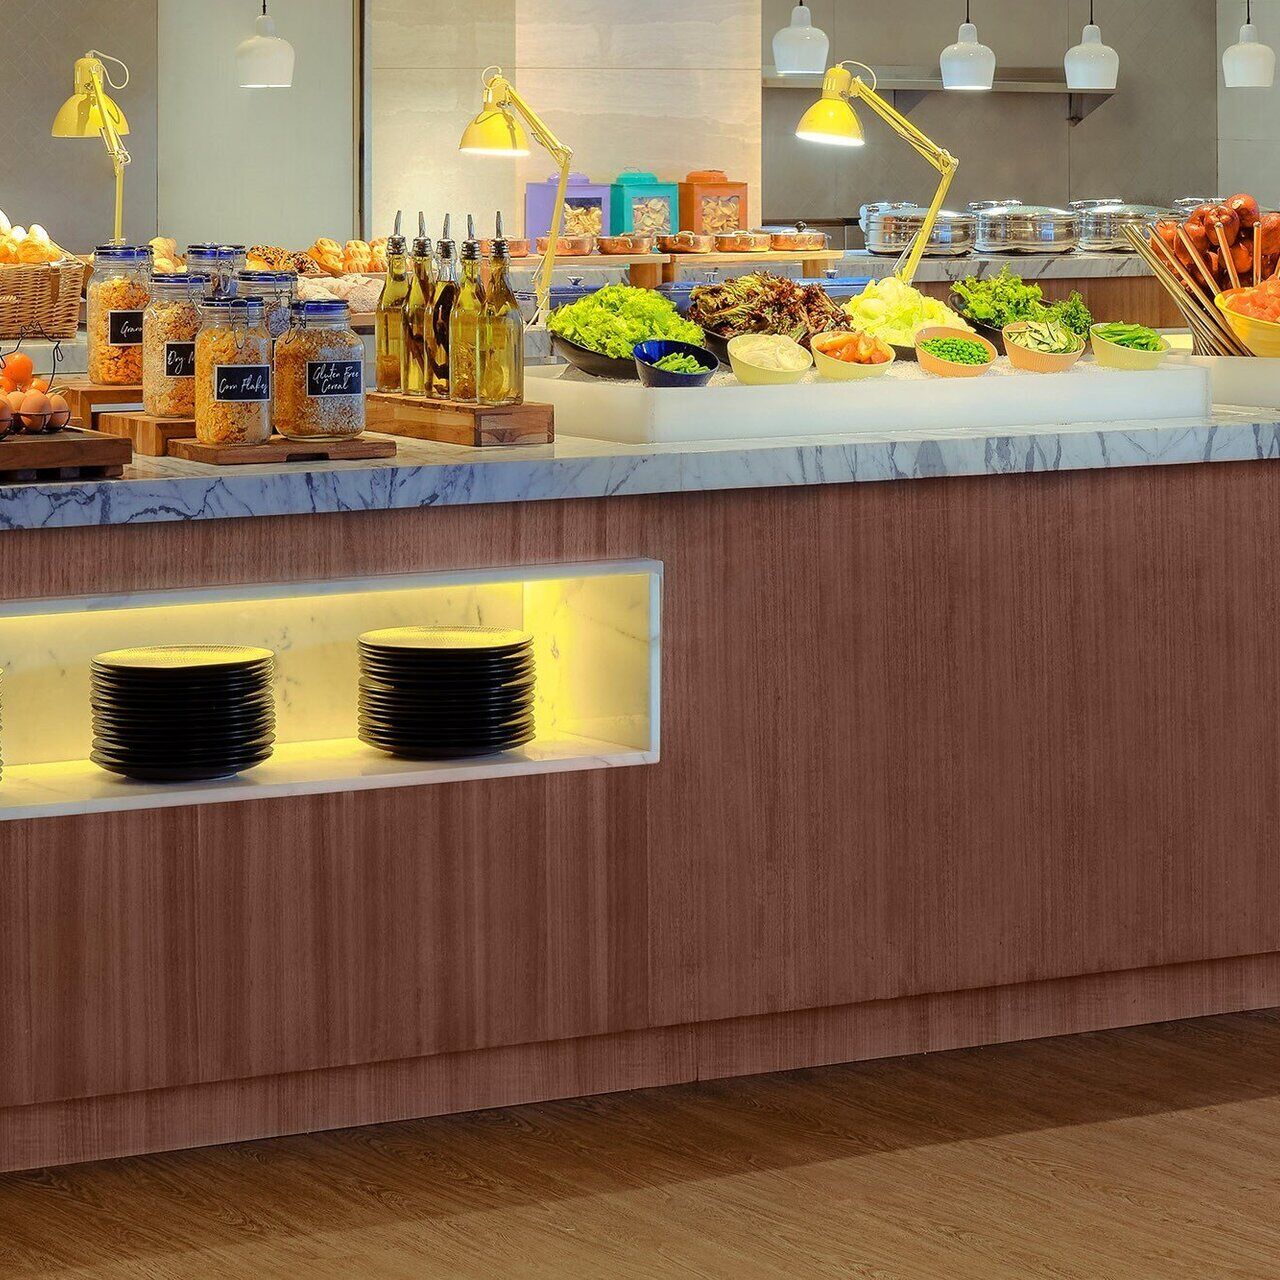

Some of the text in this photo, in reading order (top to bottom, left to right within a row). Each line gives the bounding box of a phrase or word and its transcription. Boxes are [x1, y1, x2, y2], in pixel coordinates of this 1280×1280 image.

[312, 363, 341, 384] Gluten
[218, 378, 238, 394] Corn
[321, 376, 349, 394] Cereal
